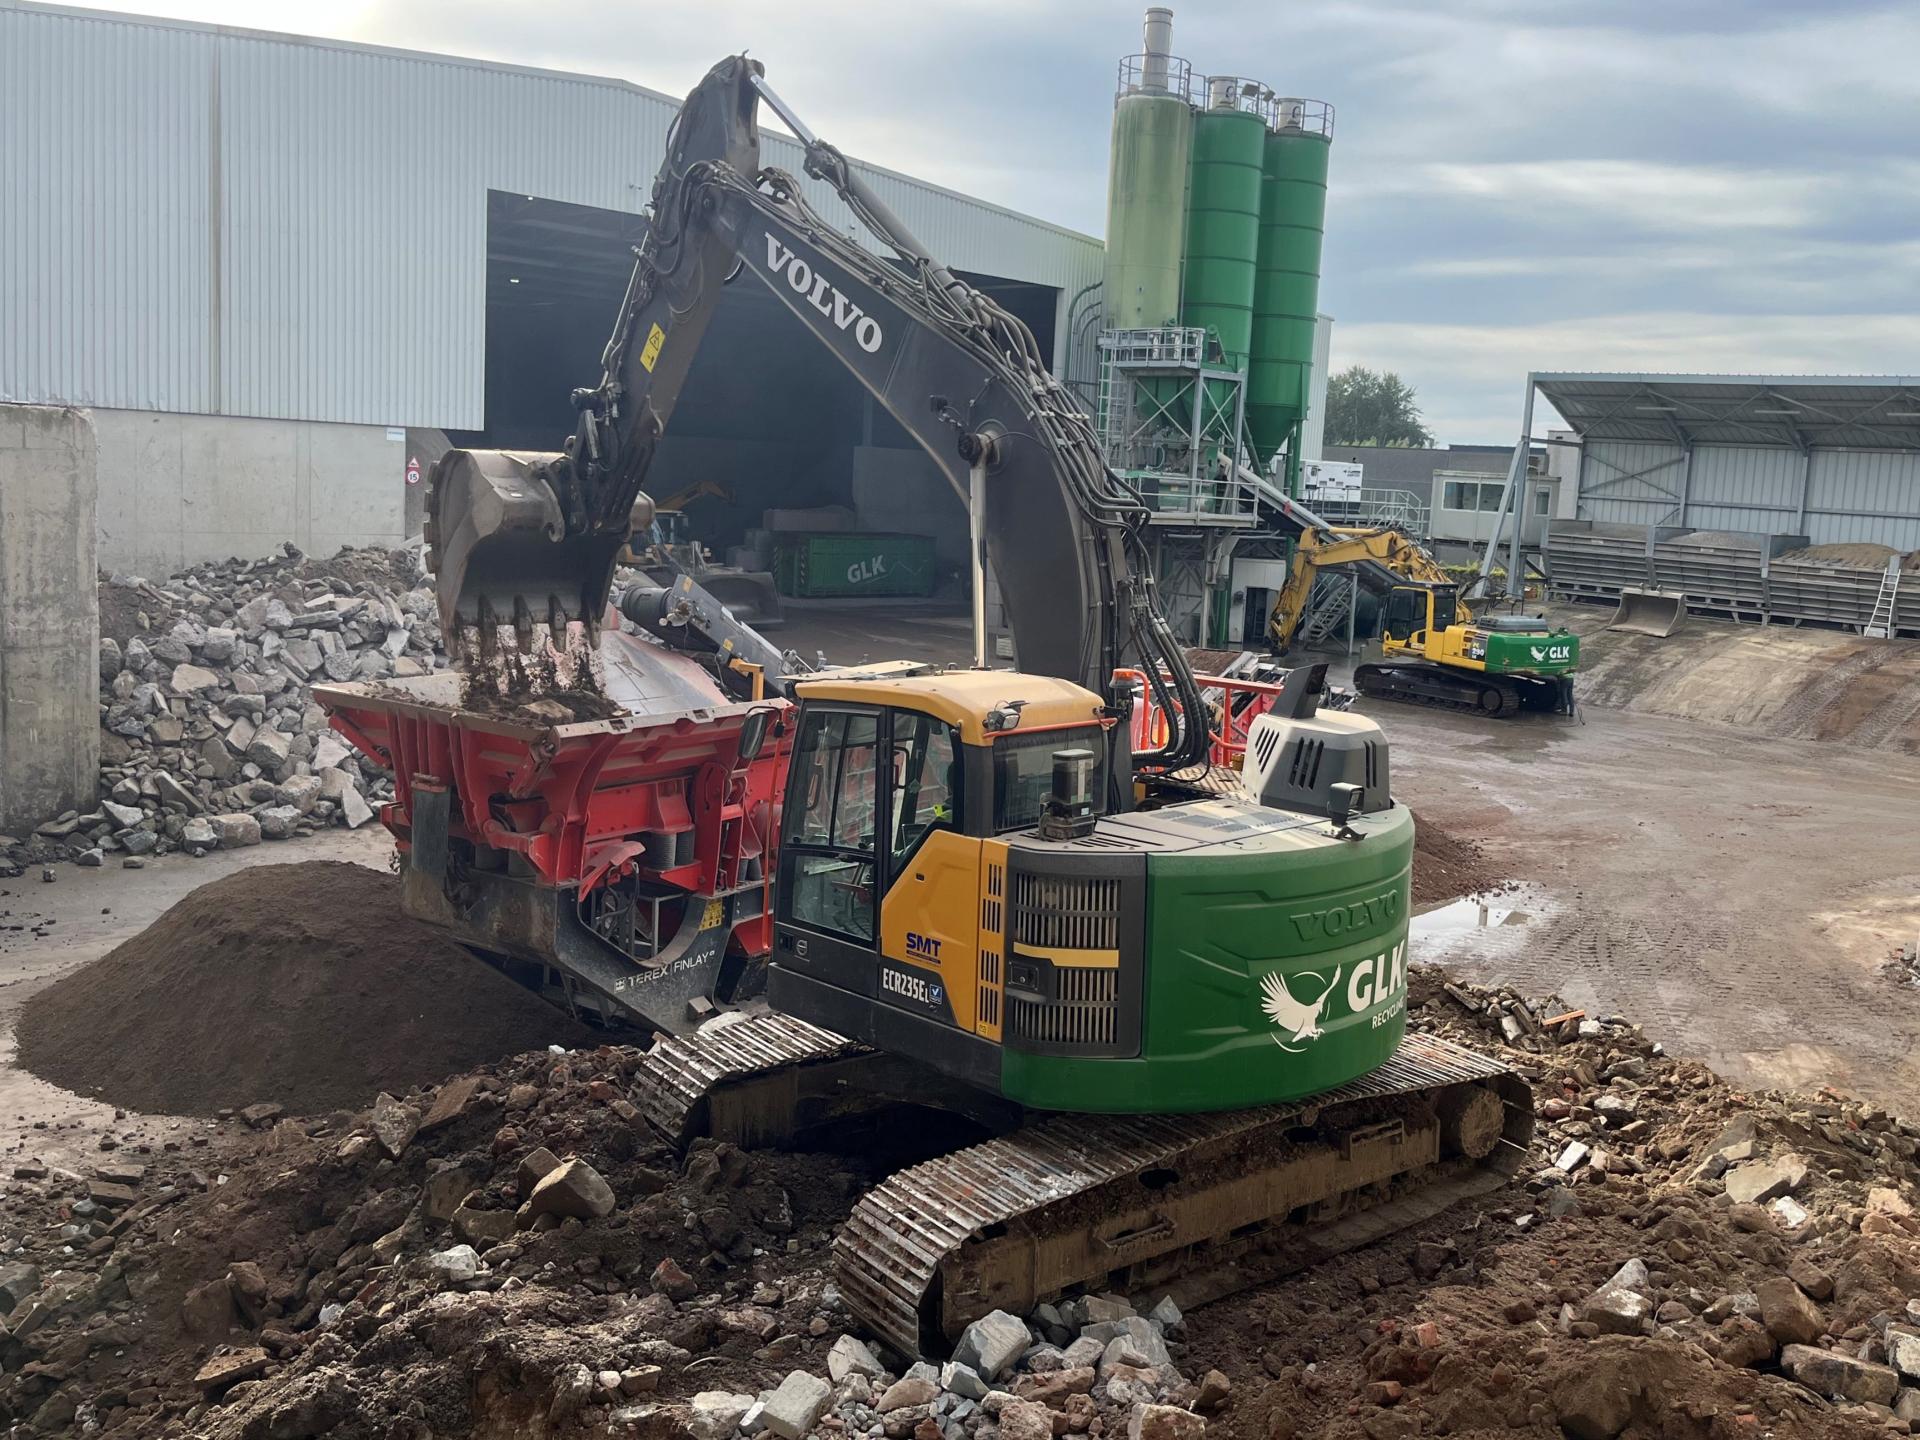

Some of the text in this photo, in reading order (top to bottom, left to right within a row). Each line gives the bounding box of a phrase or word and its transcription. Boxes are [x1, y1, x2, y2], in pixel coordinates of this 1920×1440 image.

[765, 231, 882, 353] VOLVO
[847, 555, 886, 583] GLK
[1549, 646, 1570, 659] GLK
[1289, 889, 1399, 942] VOLVO
[906, 932, 942, 957] SMT
[628, 963, 668, 987] TEREX
[1348, 939, 1405, 1013] GLK
